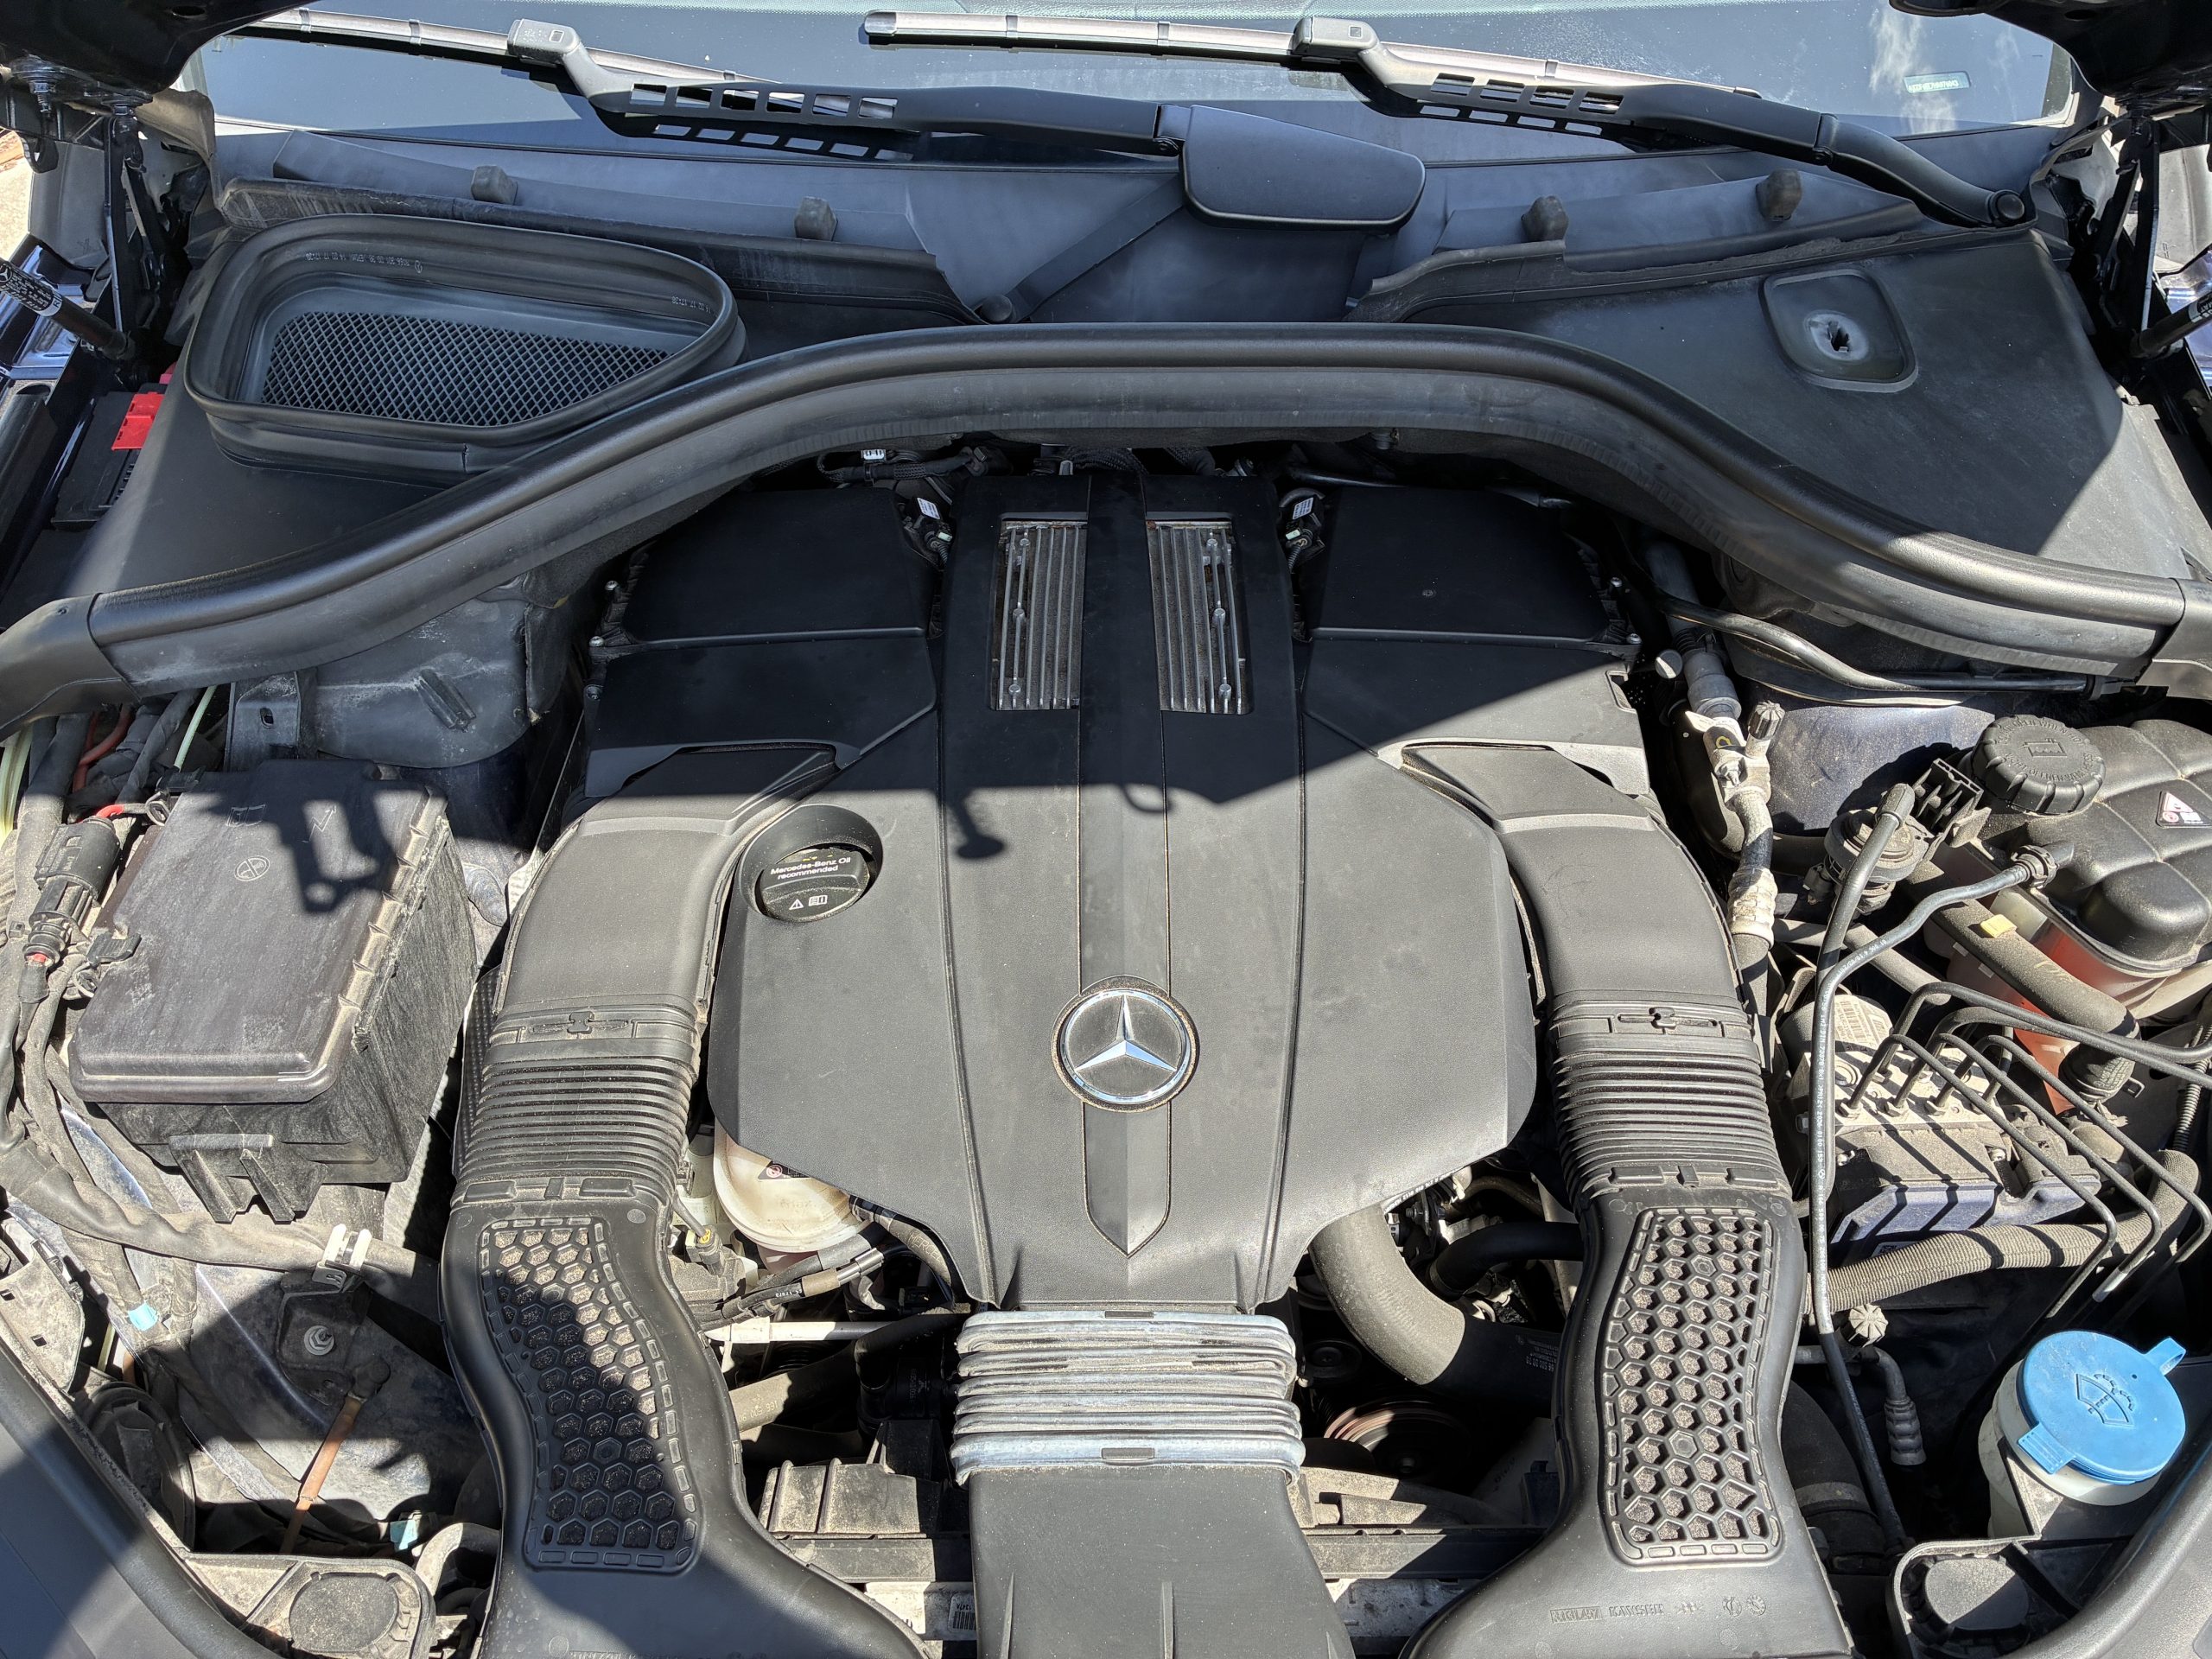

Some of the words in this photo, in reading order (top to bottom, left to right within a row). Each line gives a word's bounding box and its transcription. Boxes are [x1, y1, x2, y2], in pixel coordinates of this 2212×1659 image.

[771, 860, 837, 875] Mercedes-Benz
[838, 856, 851, 865] Oil
[778, 865, 839, 880] recommended
[766, 1400, 779, 1413] 166
